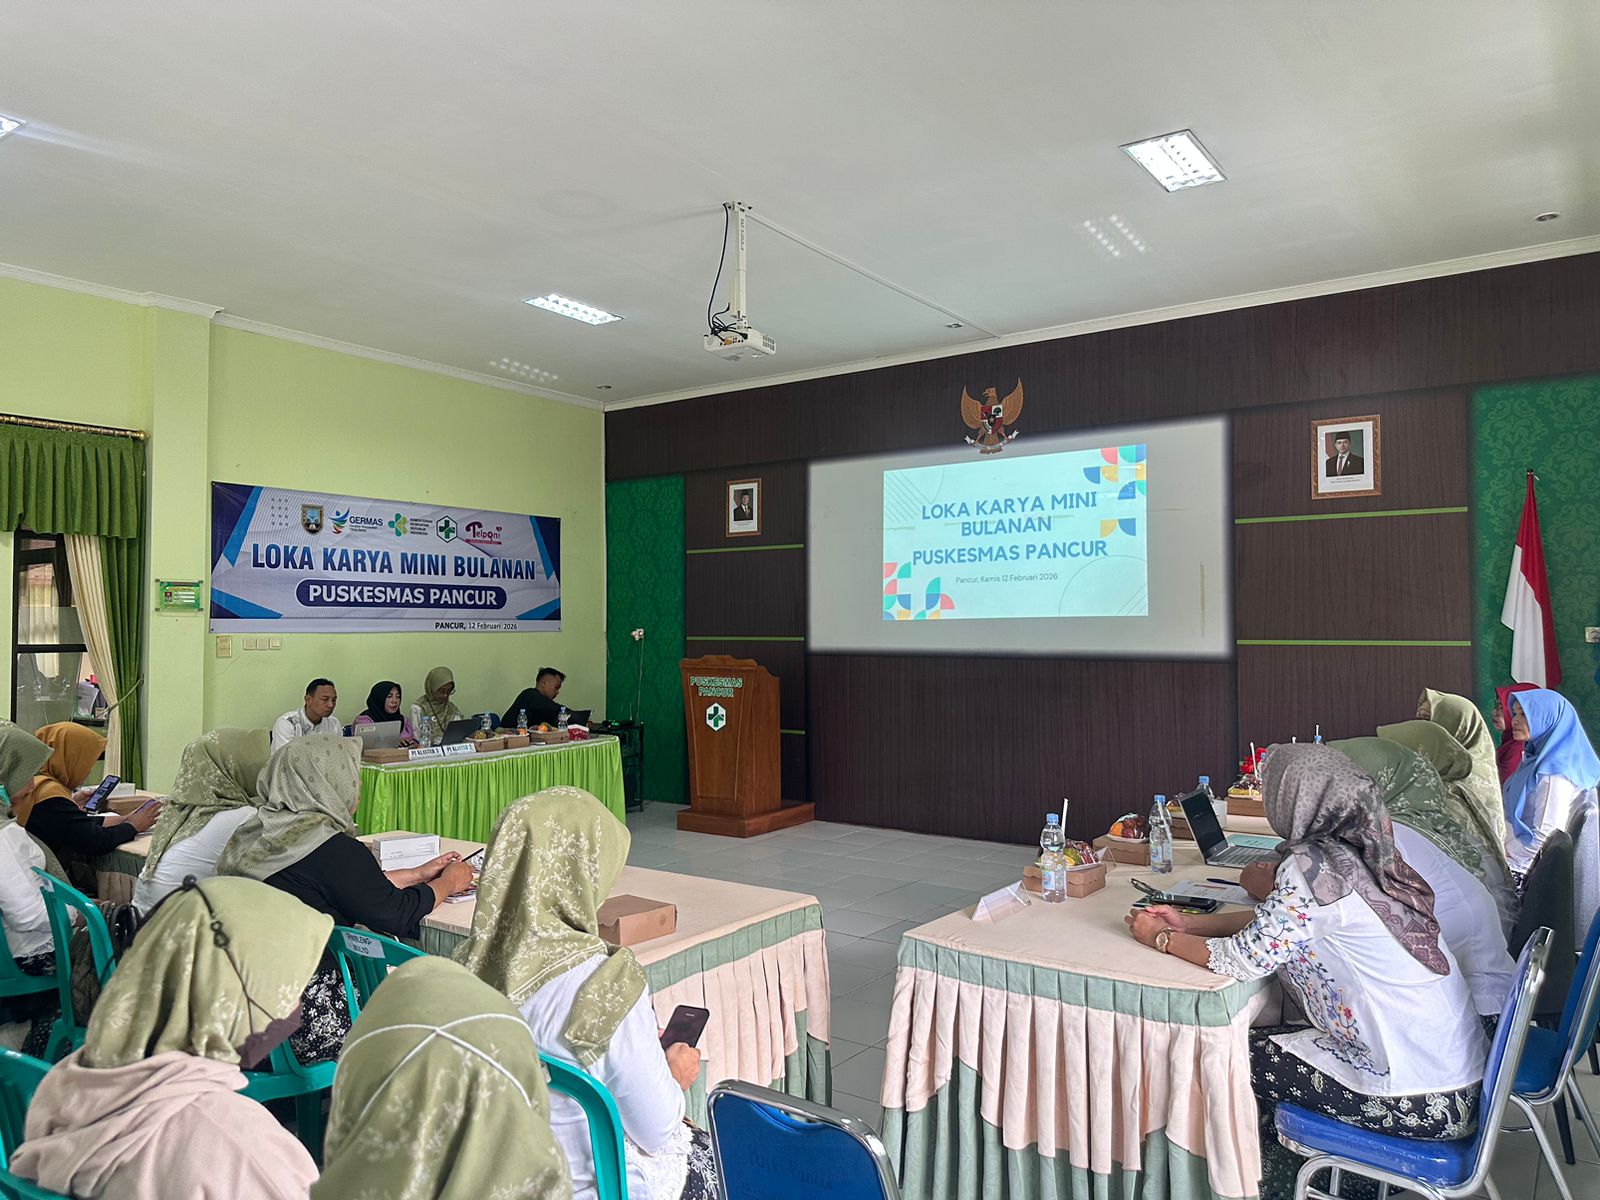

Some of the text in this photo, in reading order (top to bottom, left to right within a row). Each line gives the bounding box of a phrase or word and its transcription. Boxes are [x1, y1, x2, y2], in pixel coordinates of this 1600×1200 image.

[922, 491, 1097, 520] LOKA KARYA MINI
[349, 516, 384, 527] GERMAS
[961, 516, 1052, 536] BULANAN
[913, 540, 1108, 565] PUSKESMAS PANCUR
[252, 542, 536, 581] LOKA KARYA MINI BULANAN
[955, 572, 1058, 585] Pancur, Kamis 12 Februari 2026
[308, 583, 498, 606] PUSKESMAS PANCUR
[435, 622, 518, 631] PANCUR, 12 Februari 2026
[690, 676, 743, 688] PUSKESMAS
[698, 686, 734, 698] PANCUR
